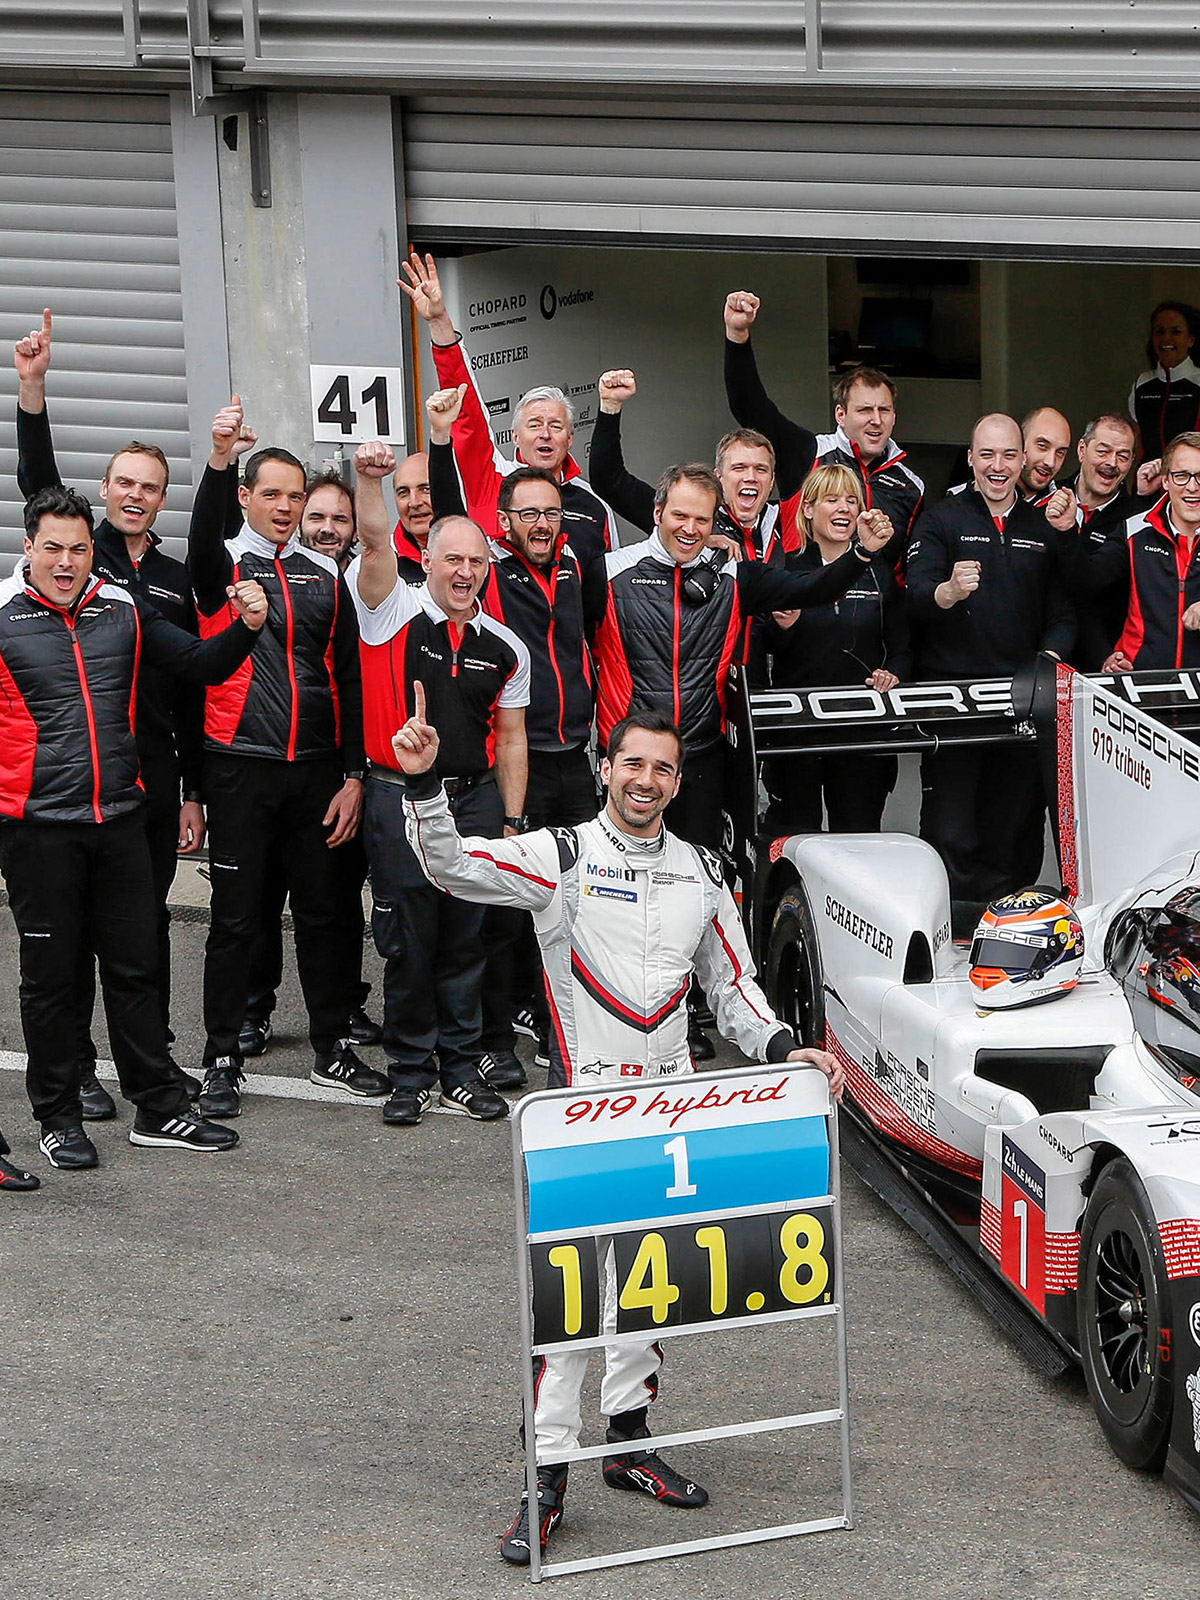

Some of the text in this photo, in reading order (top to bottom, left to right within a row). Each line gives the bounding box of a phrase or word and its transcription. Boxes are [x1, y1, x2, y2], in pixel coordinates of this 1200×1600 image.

[469, 294, 527, 317] CHOPARD
[558, 289, 595, 307] vodafone
[471, 345, 529, 370] SCHAEFFLER
[570, 382, 597, 394] TRILUX
[317, 374, 390, 436] 41
[496, 429, 512, 446] VELT
[960, 535, 991, 543] CHOPARD
[1144, 545, 1170, 556] CHOPAR
[631, 577, 668, 587] CHOPARD
[9, 611, 50, 622] CHOPARD
[1092, 694, 1200, 783] PORSCHE
[1091, 726, 1151, 791] 919 tribute
[586, 863, 637, 882] Mobil 1
[600, 888, 634, 900] MICHELIN
[825, 894, 895, 960] SCHAEFFLER
[974, 927, 1044, 949] RSCHE
[658, 1060, 678, 1076] Neel
[564, 1077, 791, 1128] 919 hybrid
[1038, 1124, 1075, 1164] CHOPARD
[663, 1135, 697, 1199] 1
[1016, 1166, 1025, 1183] LE
[1024, 1174, 1045, 1199] MANS
[1013, 1199, 1028, 1290] 1
